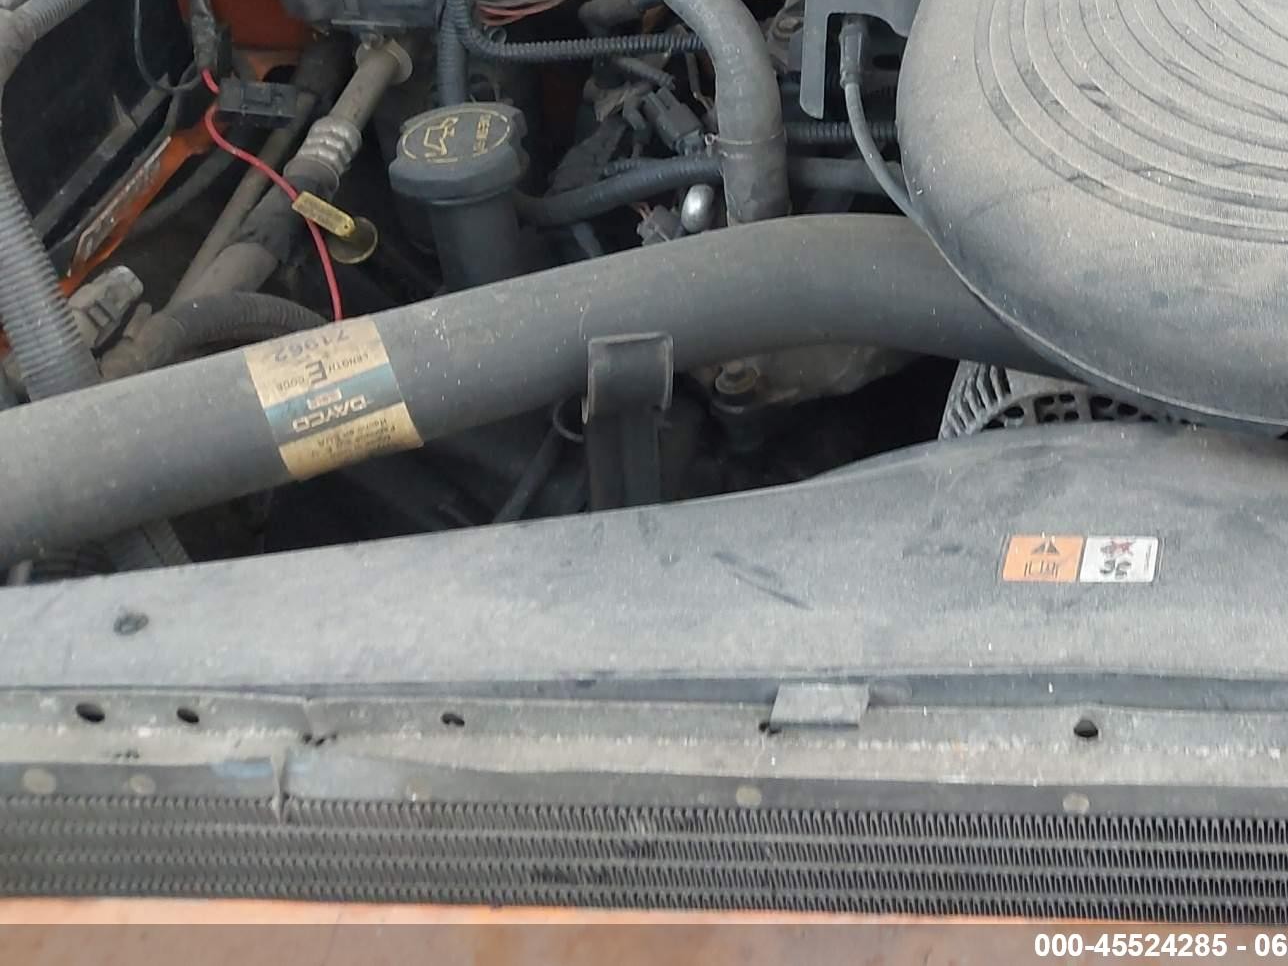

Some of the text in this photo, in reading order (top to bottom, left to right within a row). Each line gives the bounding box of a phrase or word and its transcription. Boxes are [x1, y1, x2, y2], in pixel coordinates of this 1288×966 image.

[276, 352, 370, 392] LENGTH E CODE
[292, 395, 368, 433] DAYCO
